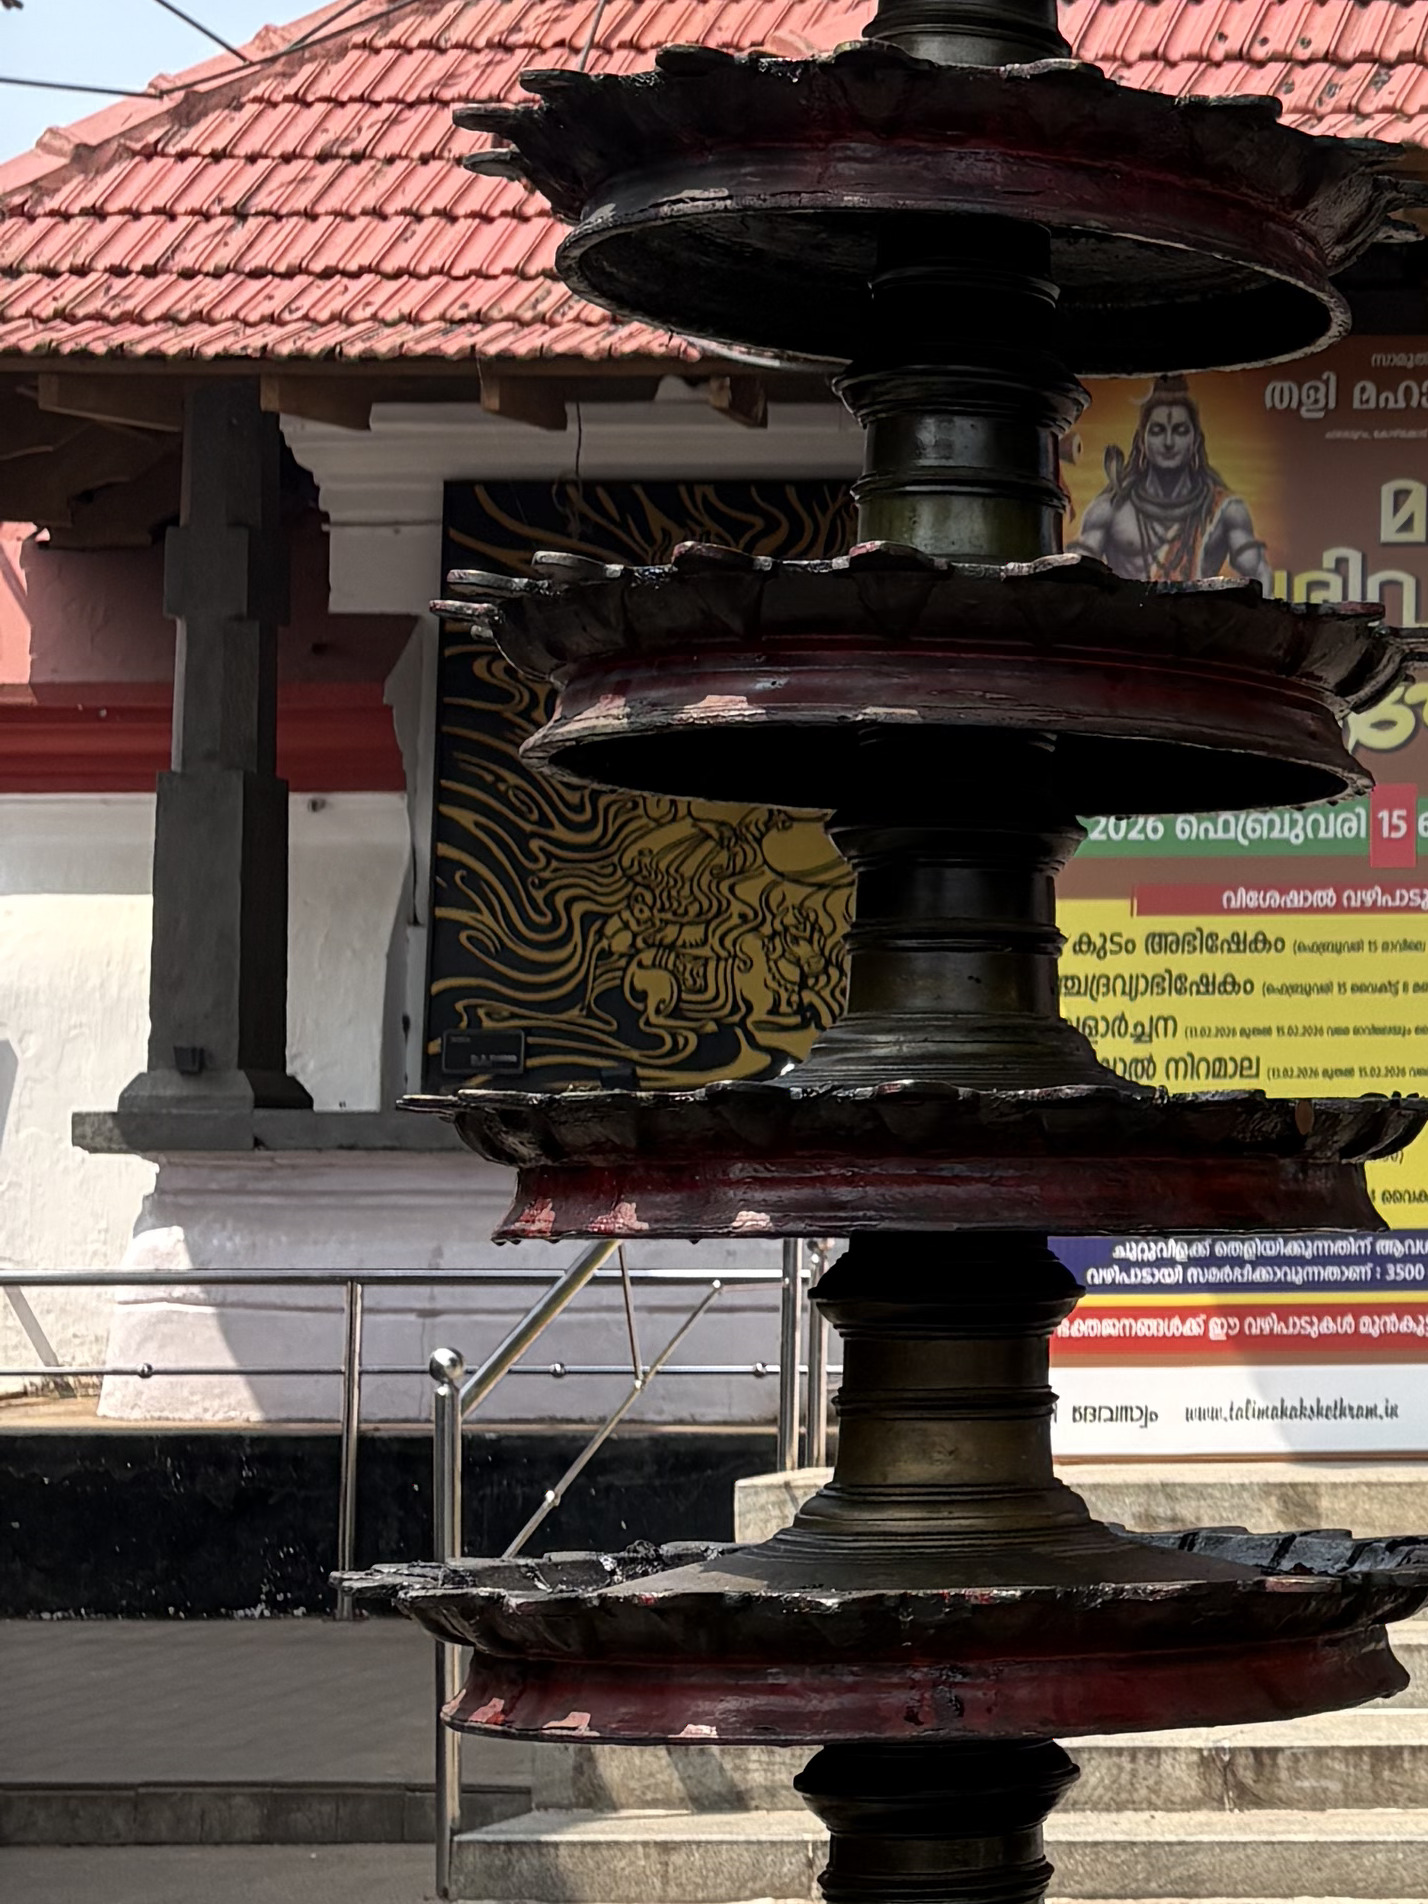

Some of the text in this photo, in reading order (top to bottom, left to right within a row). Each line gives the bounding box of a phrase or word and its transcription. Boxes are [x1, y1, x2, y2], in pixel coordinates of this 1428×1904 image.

[1263, 371, 1337, 419] തളി
[1088, 813, 1164, 842] 2026
[1174, 804, 1367, 848] ഫെബ്രുവരി
[1378, 808, 1409, 839] 15
[1221, 886, 1337, 911] വിശേഷാൽ
[1144, 927, 1286, 956] അഭിഷേകം
[1165, 1051, 1261, 1082] നിറമാല
[1385, 1262, 1425, 1282] 3500
[1208, 1316, 1241, 1342] ഈ
